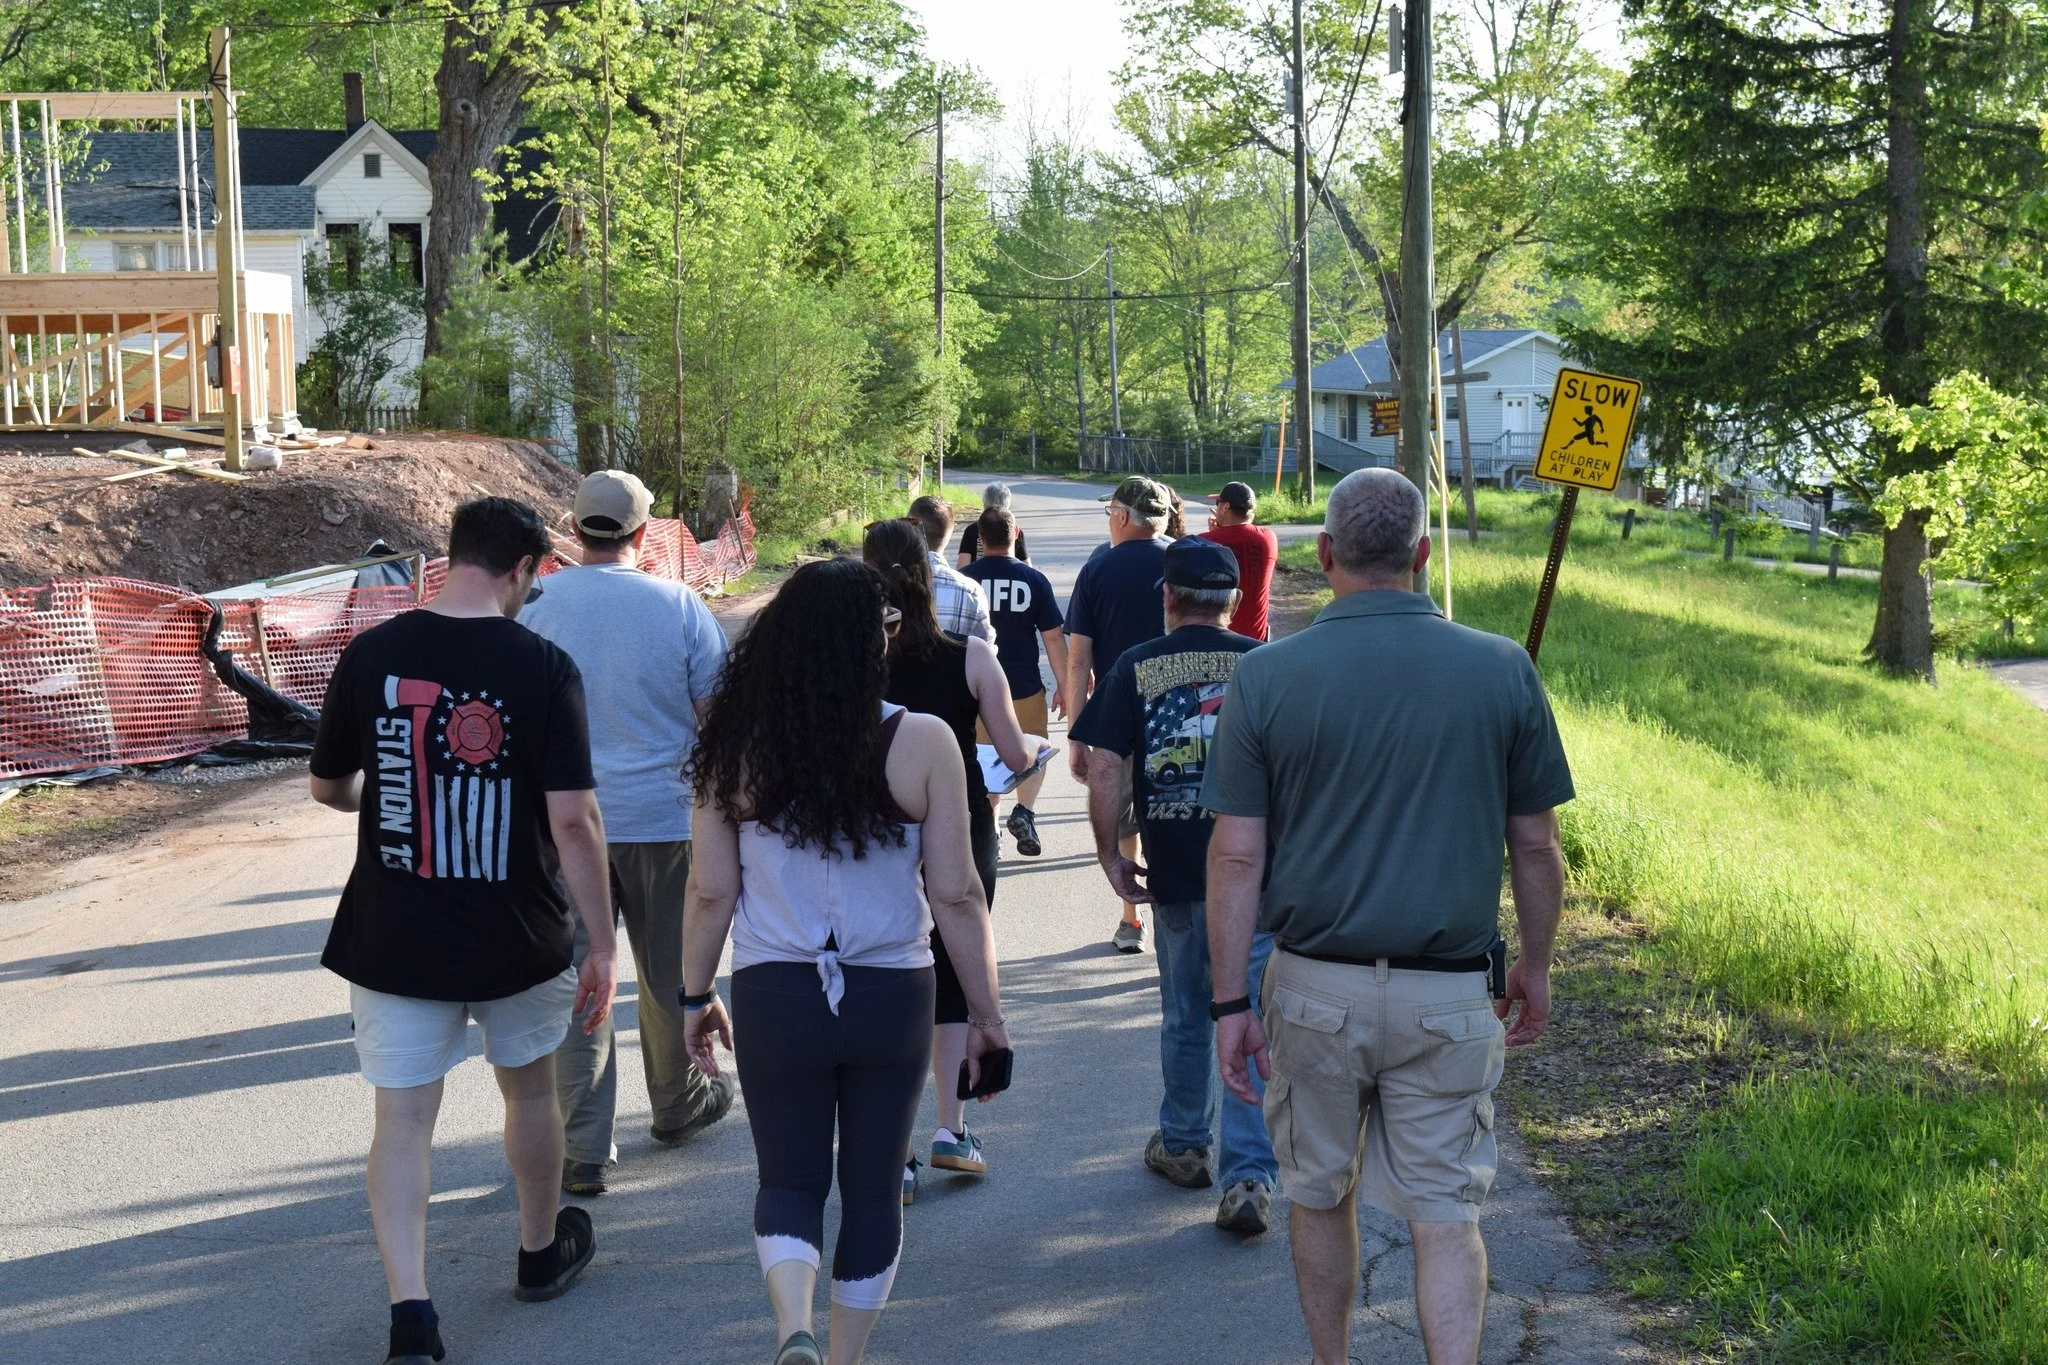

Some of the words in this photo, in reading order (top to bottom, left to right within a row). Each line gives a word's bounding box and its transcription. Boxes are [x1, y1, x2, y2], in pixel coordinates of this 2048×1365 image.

[1564, 378, 1631, 409] SLOW
[1550, 450, 1611, 471] CHILDREN
[1550, 463, 1565, 474] AT
[1572, 467, 1604, 482] PLAY
[376, 717, 412, 834] STATION
[380, 843, 413, 873] 13
